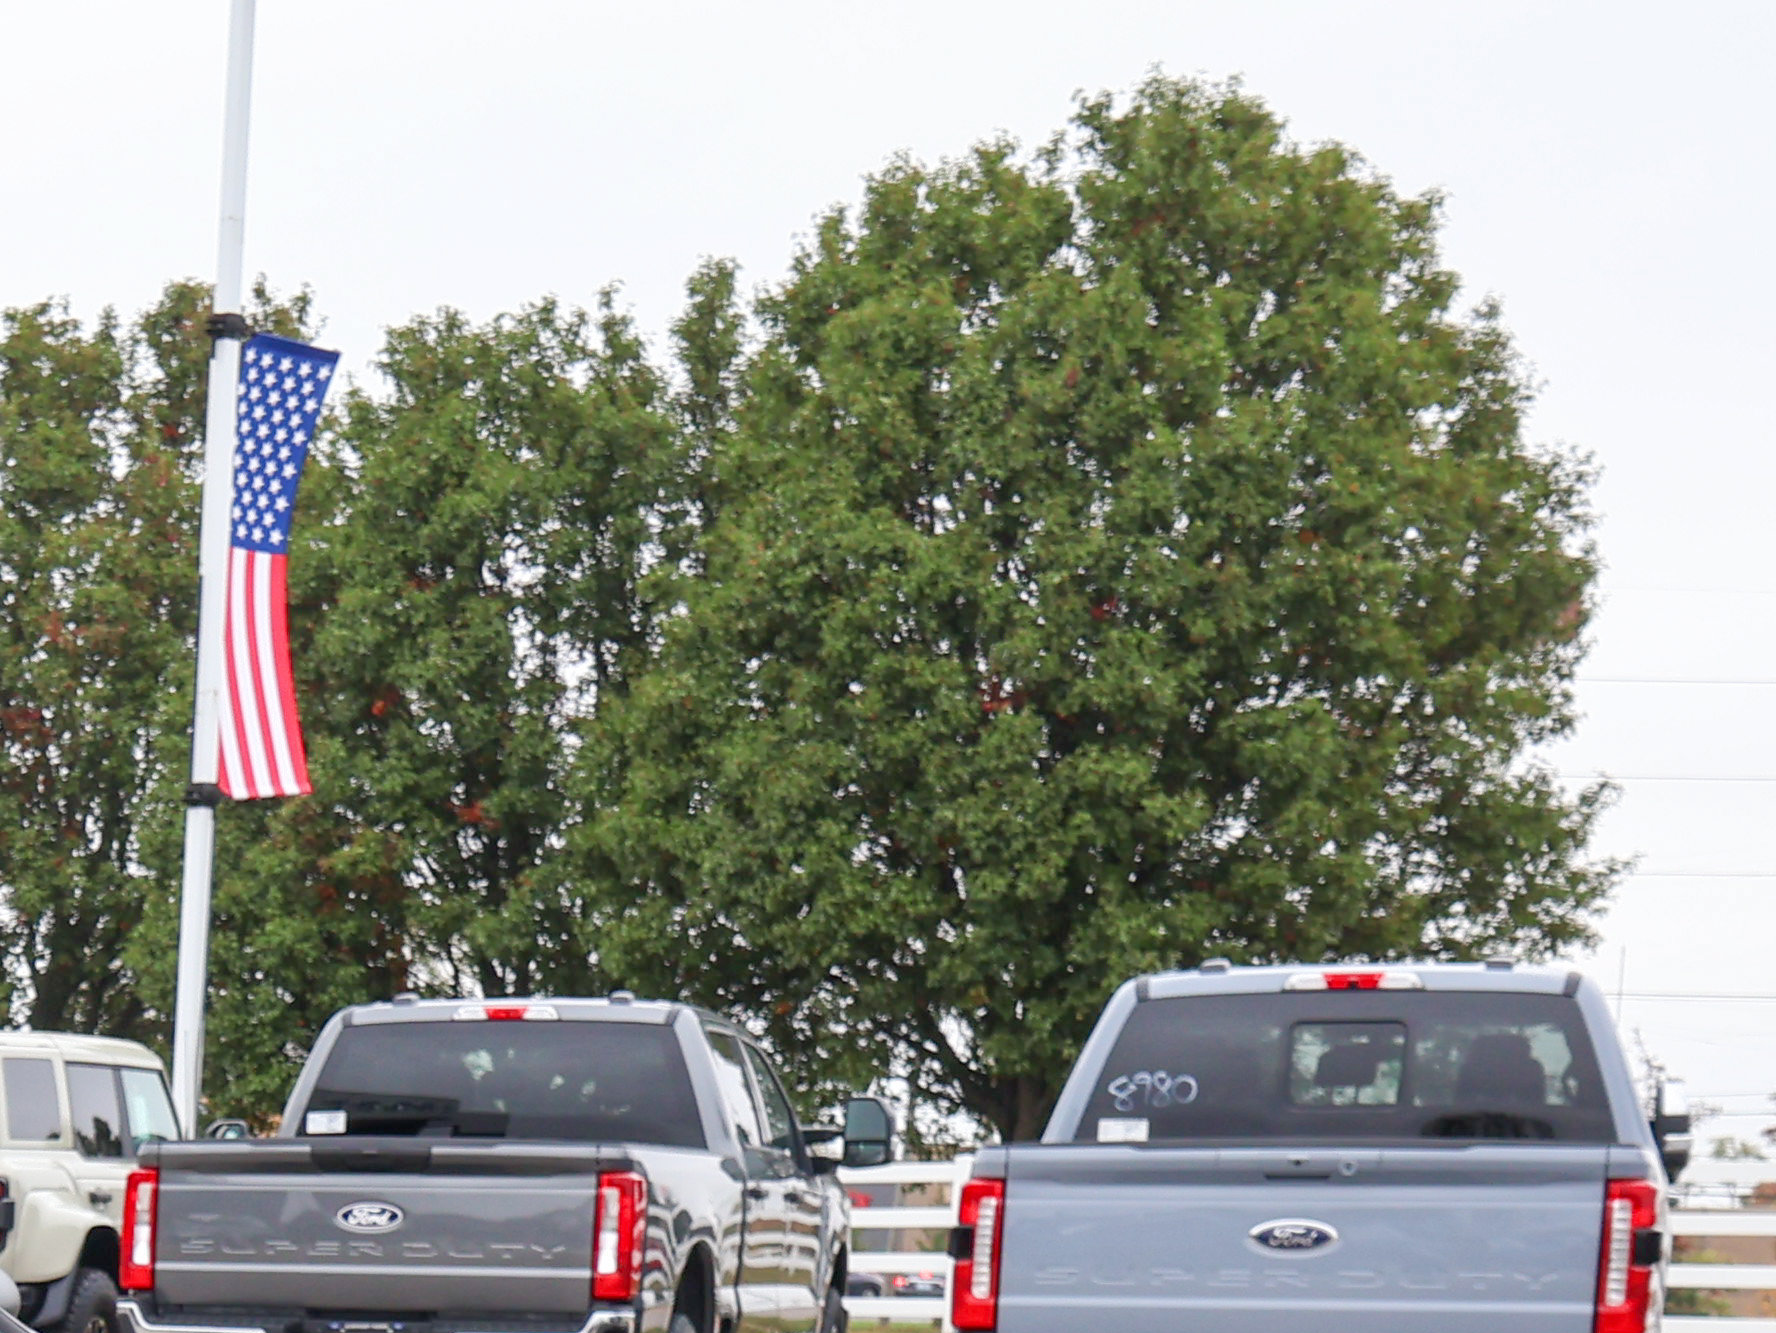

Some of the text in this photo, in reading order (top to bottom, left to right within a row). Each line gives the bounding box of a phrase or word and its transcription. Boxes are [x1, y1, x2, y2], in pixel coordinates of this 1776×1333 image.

[1108, 1070, 1198, 1112] 8980
[348, 1206, 393, 1227] Ford
[1269, 1228, 1318, 1248] Ford
[180, 1239, 566, 1259] SUPER DUTY
[1035, 1267, 1558, 1291] SUPER DUTY
